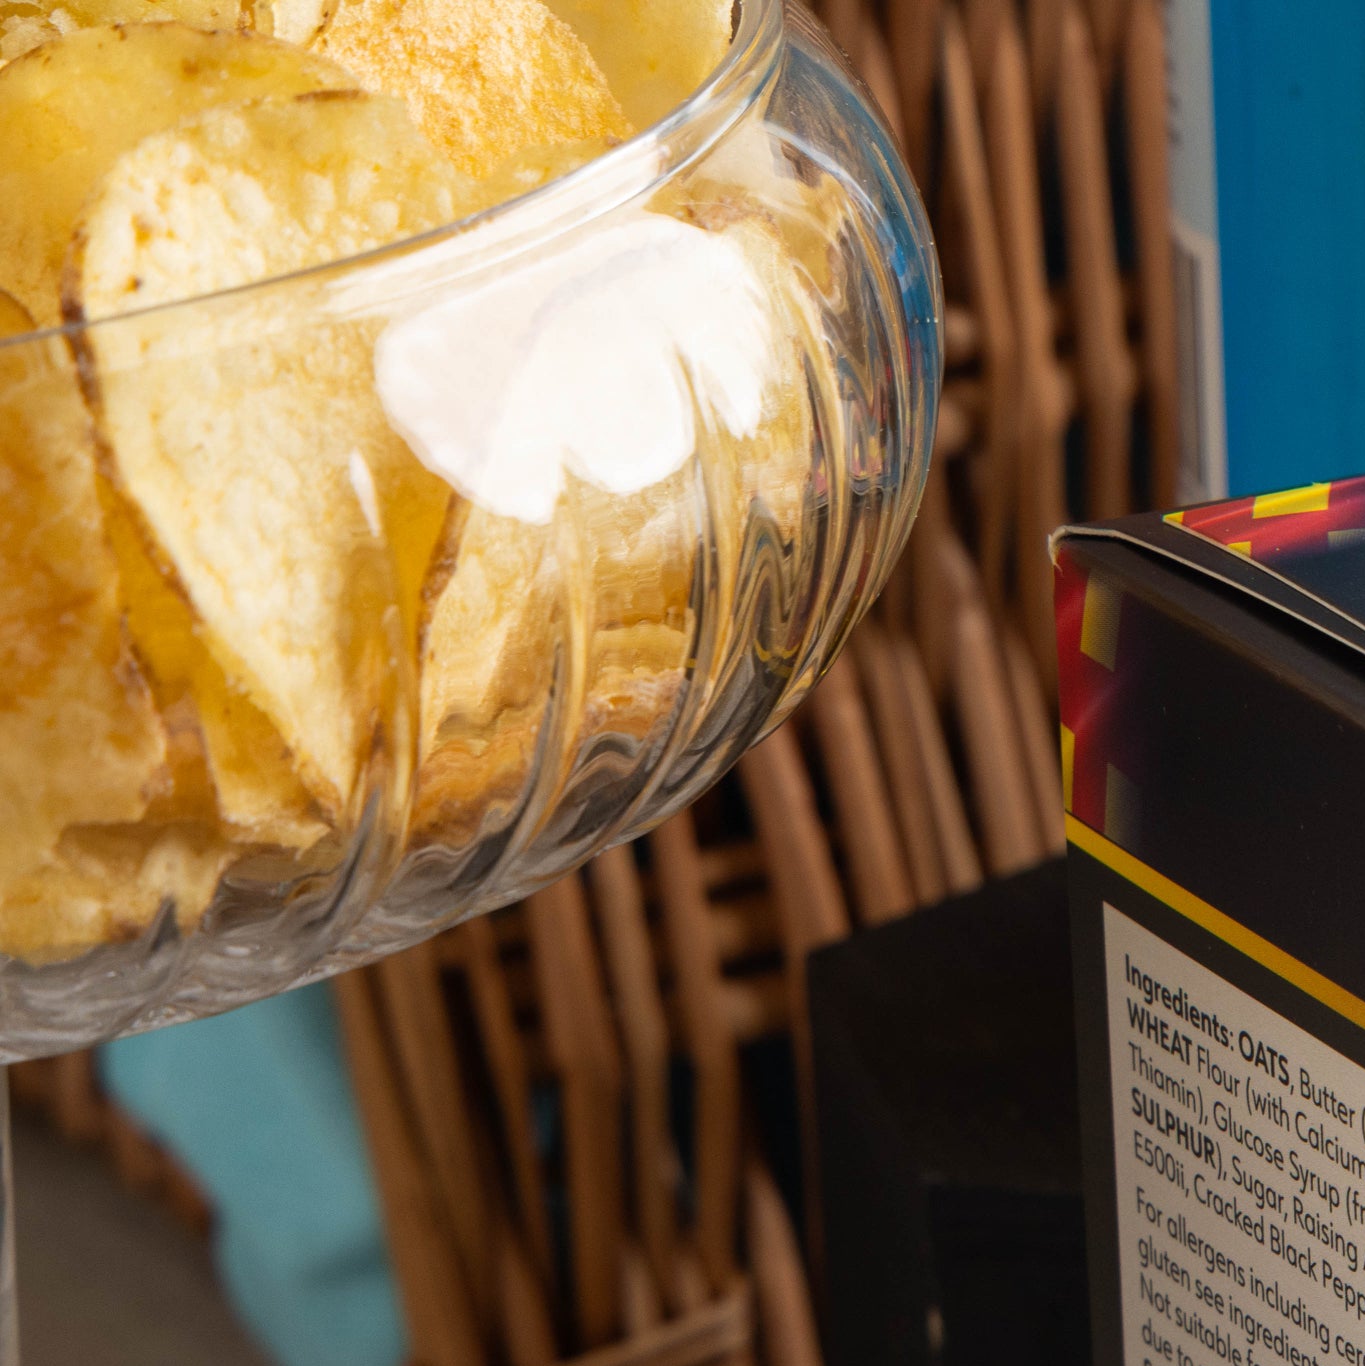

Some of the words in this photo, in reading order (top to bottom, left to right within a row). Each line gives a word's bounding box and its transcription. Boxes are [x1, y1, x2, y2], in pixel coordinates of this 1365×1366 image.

[1125, 953, 1234, 1052] Ingredients:
[1237, 1030, 1295, 1096] OATS,
[1299, 1067, 1356, 1129] Butter
[1126, 997, 1193, 1066] WHEAT
[1196, 1044, 1241, 1098] Flour
[1245, 1076, 1291, 1133] (with
[1128, 1041, 1209, 1126] Thiamin),
[1212, 1100, 1285, 1172] Glucose
[1288, 1150, 1341, 1213] Syrup
[1131, 1086, 1228, 1182] SULPHUR),
[1231, 1155, 1288, 1223] Sugar,
[1292, 1195, 1359, 1273] Raising
[1133, 1129, 1190, 1198] E500ii,
[1193, 1173, 1265, 1246] Cracked
[1269, 1223, 1319, 1283] Black
[1136, 1185, 1163, 1228] For
[1166, 1213, 1246, 1288] allergens
[1249, 1266, 1331, 1355] including
[1138, 1235, 1191, 1292] gluten
[1194, 1278, 1225, 1315] see
[1140, 1272, 1172, 1320] Not
[1141, 1318, 1174, 1362] due
